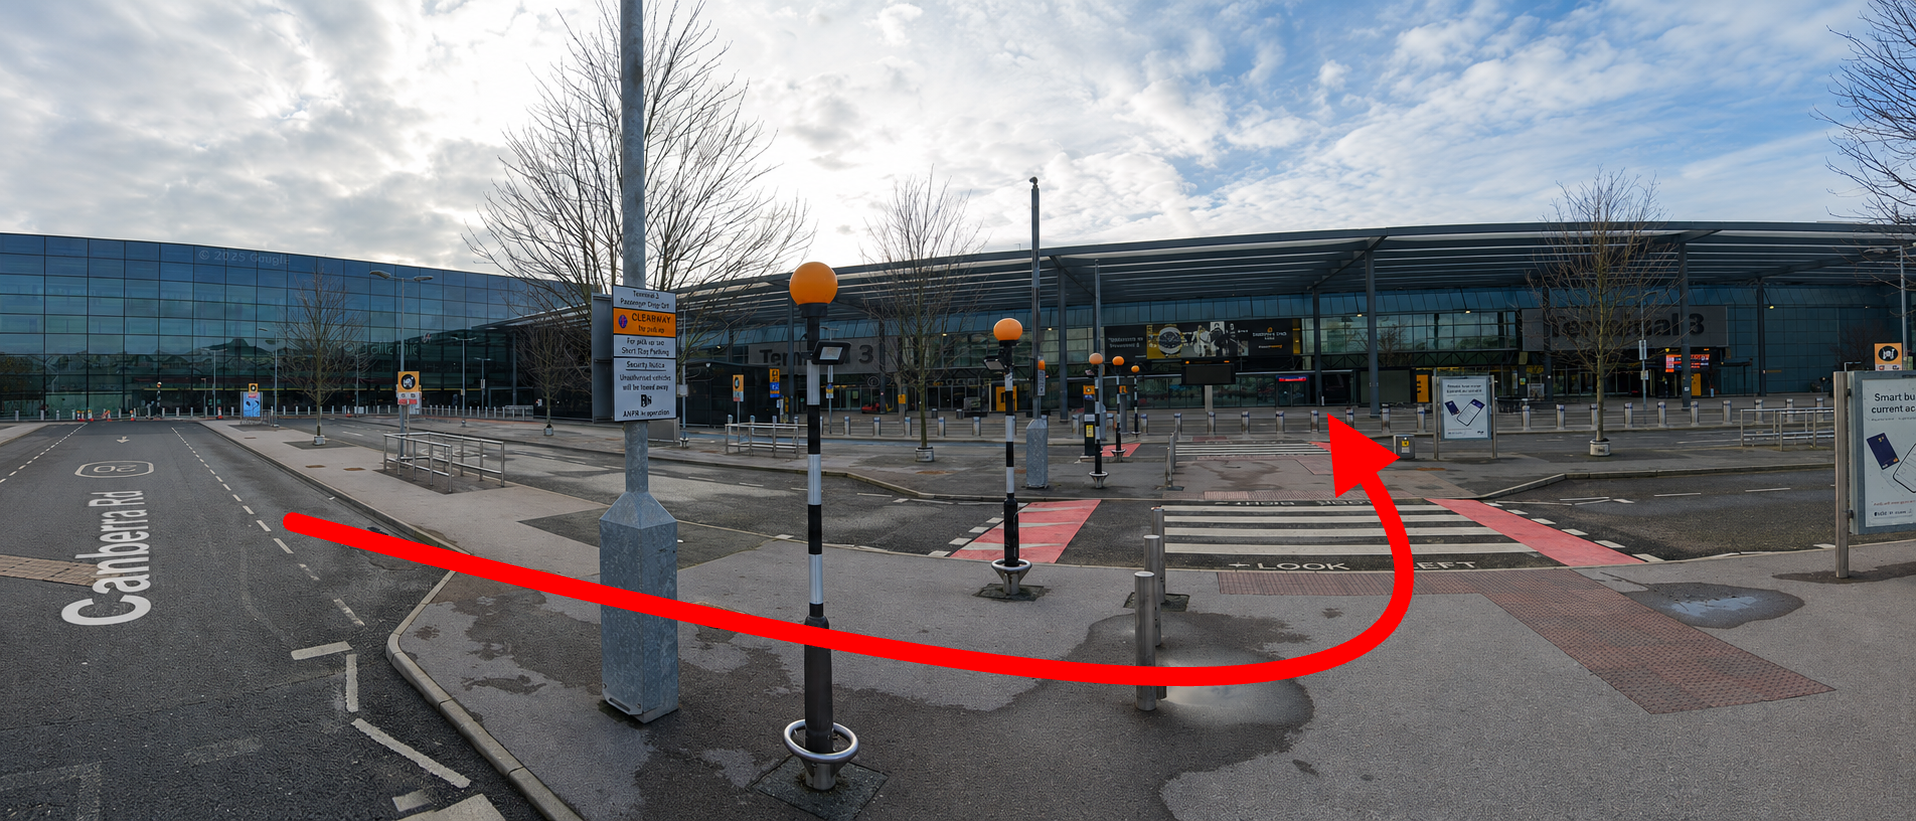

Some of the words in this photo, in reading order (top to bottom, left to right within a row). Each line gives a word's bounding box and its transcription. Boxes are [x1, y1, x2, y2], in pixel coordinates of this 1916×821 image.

[858, 344, 874, 364] 3
[1874, 392, 1902, 402] Smart
[1872, 406, 1903, 414] current
[94, 464, 138, 473] 20
[88, 490, 145, 507] Rd
[61, 509, 151, 626] Canberra
